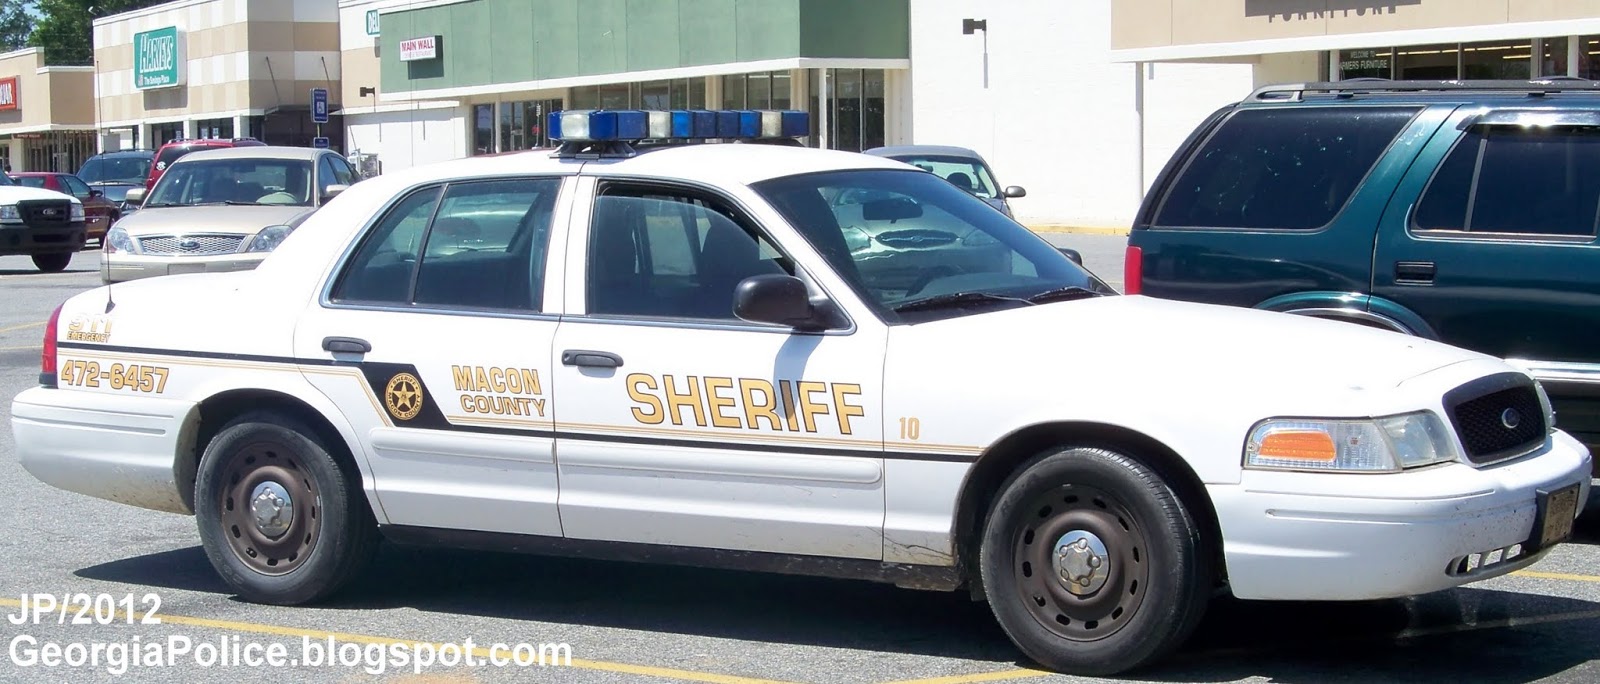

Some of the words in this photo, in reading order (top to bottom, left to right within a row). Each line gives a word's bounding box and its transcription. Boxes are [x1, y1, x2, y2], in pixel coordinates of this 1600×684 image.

[401, 41, 416, 51] MAIN
[417, 39, 434, 50] WALL
[1360, 60, 1387, 69] FURNITURE
[67, 331, 111, 343] EMERGENCY
[61, 359, 169, 394] 472-6457
[451, 365, 542, 395] MACON
[460, 394, 545, 417] COUNTY
[626, 373, 865, 435] SHERIFF
[899, 416, 920, 440] 10
